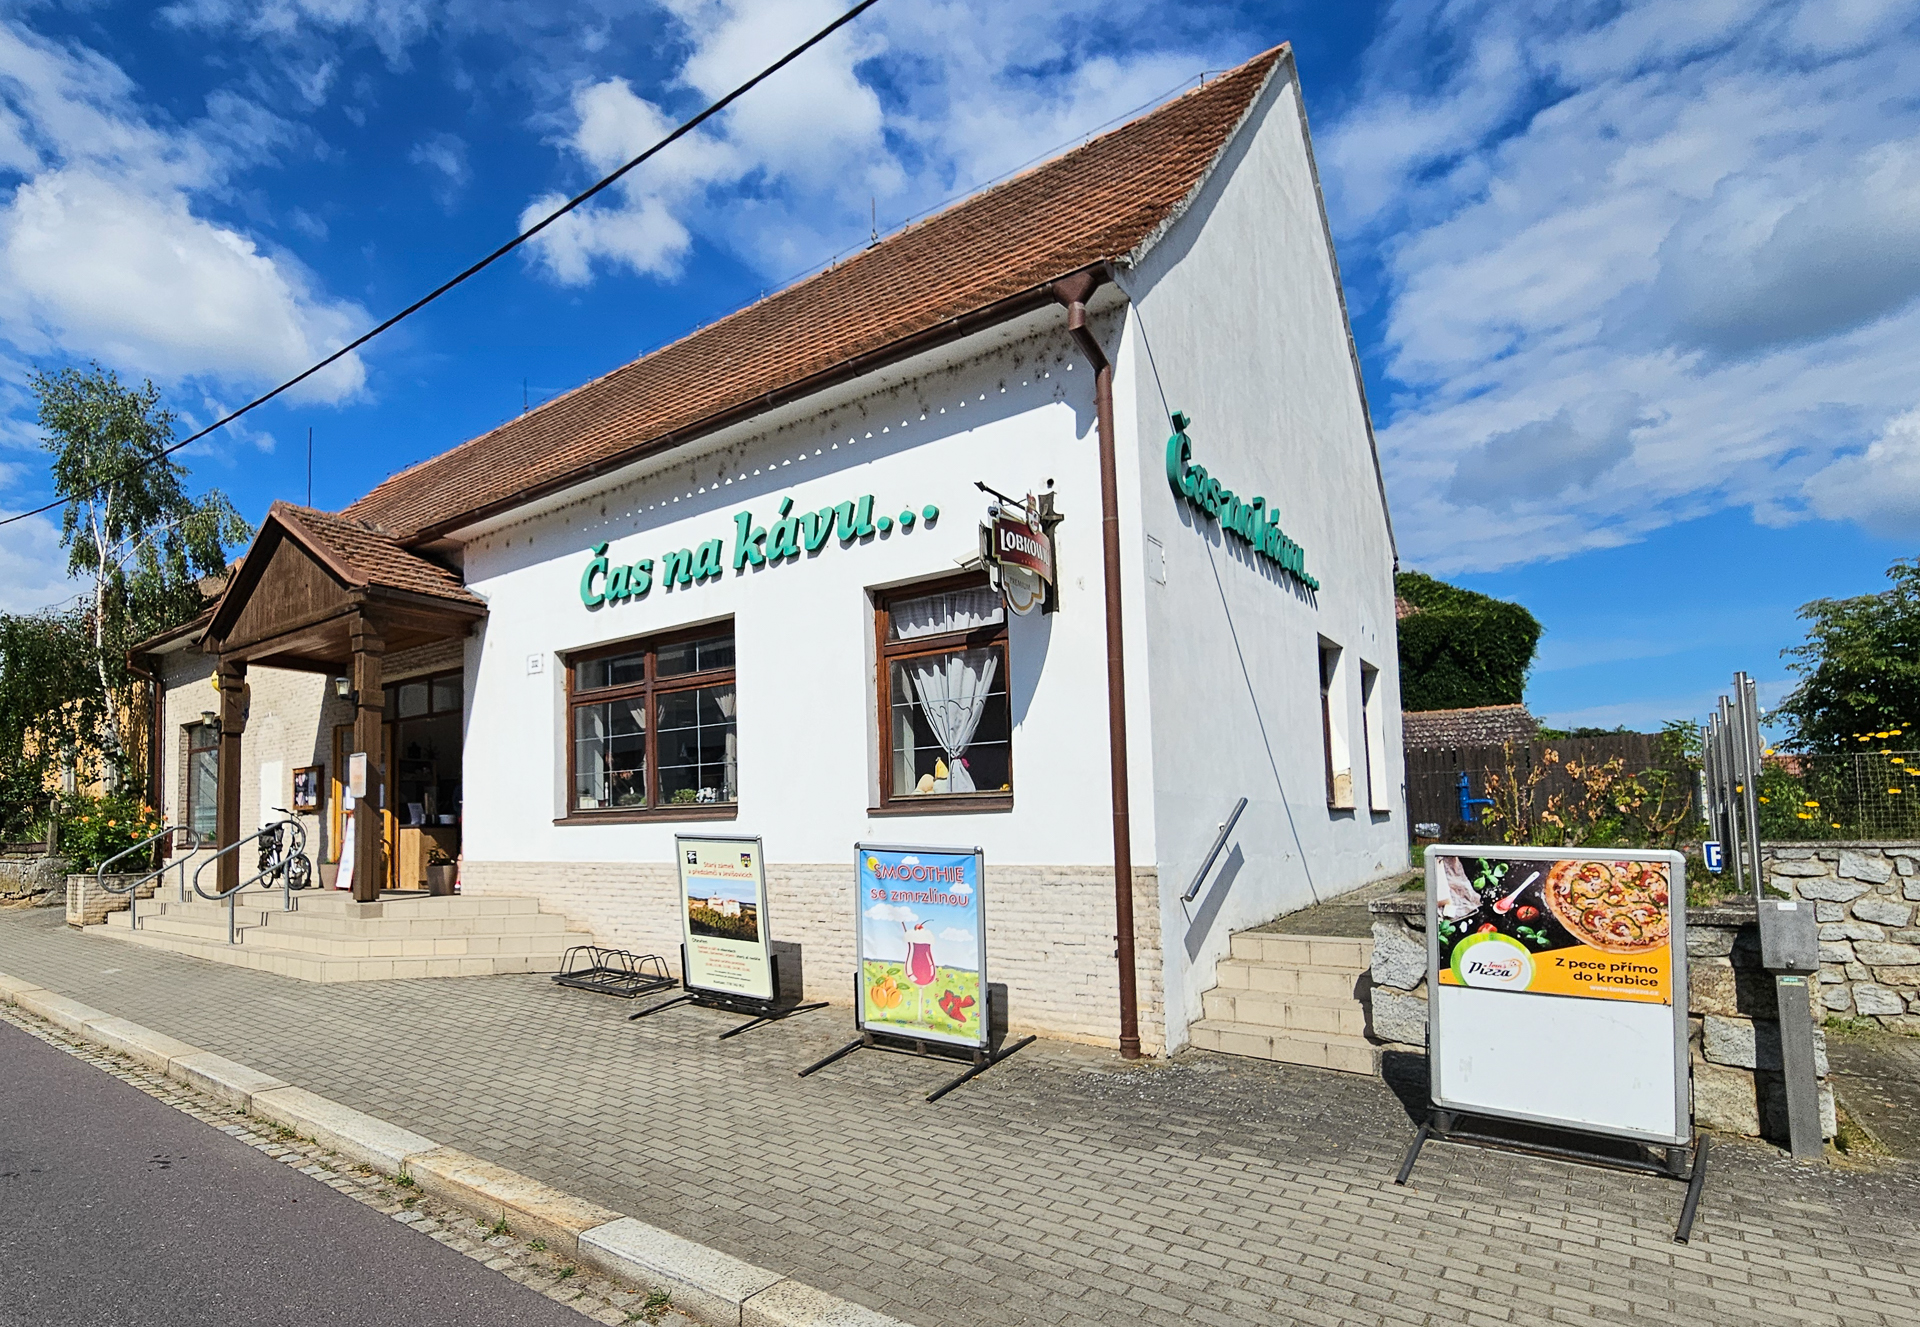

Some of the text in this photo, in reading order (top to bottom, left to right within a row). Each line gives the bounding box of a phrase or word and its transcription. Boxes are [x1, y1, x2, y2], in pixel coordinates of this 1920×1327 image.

[580, 494, 940, 606] Čas na kávu...
[873, 863, 965, 884] SMOOTHIE
[870, 887, 969, 907] se zmrzlinou
[1468, 960, 1512, 978] Pizza
[1568, 960, 1606, 972] pece
[1610, 962, 1659, 974] přímo
[1573, 971, 1659, 987] do krabice
